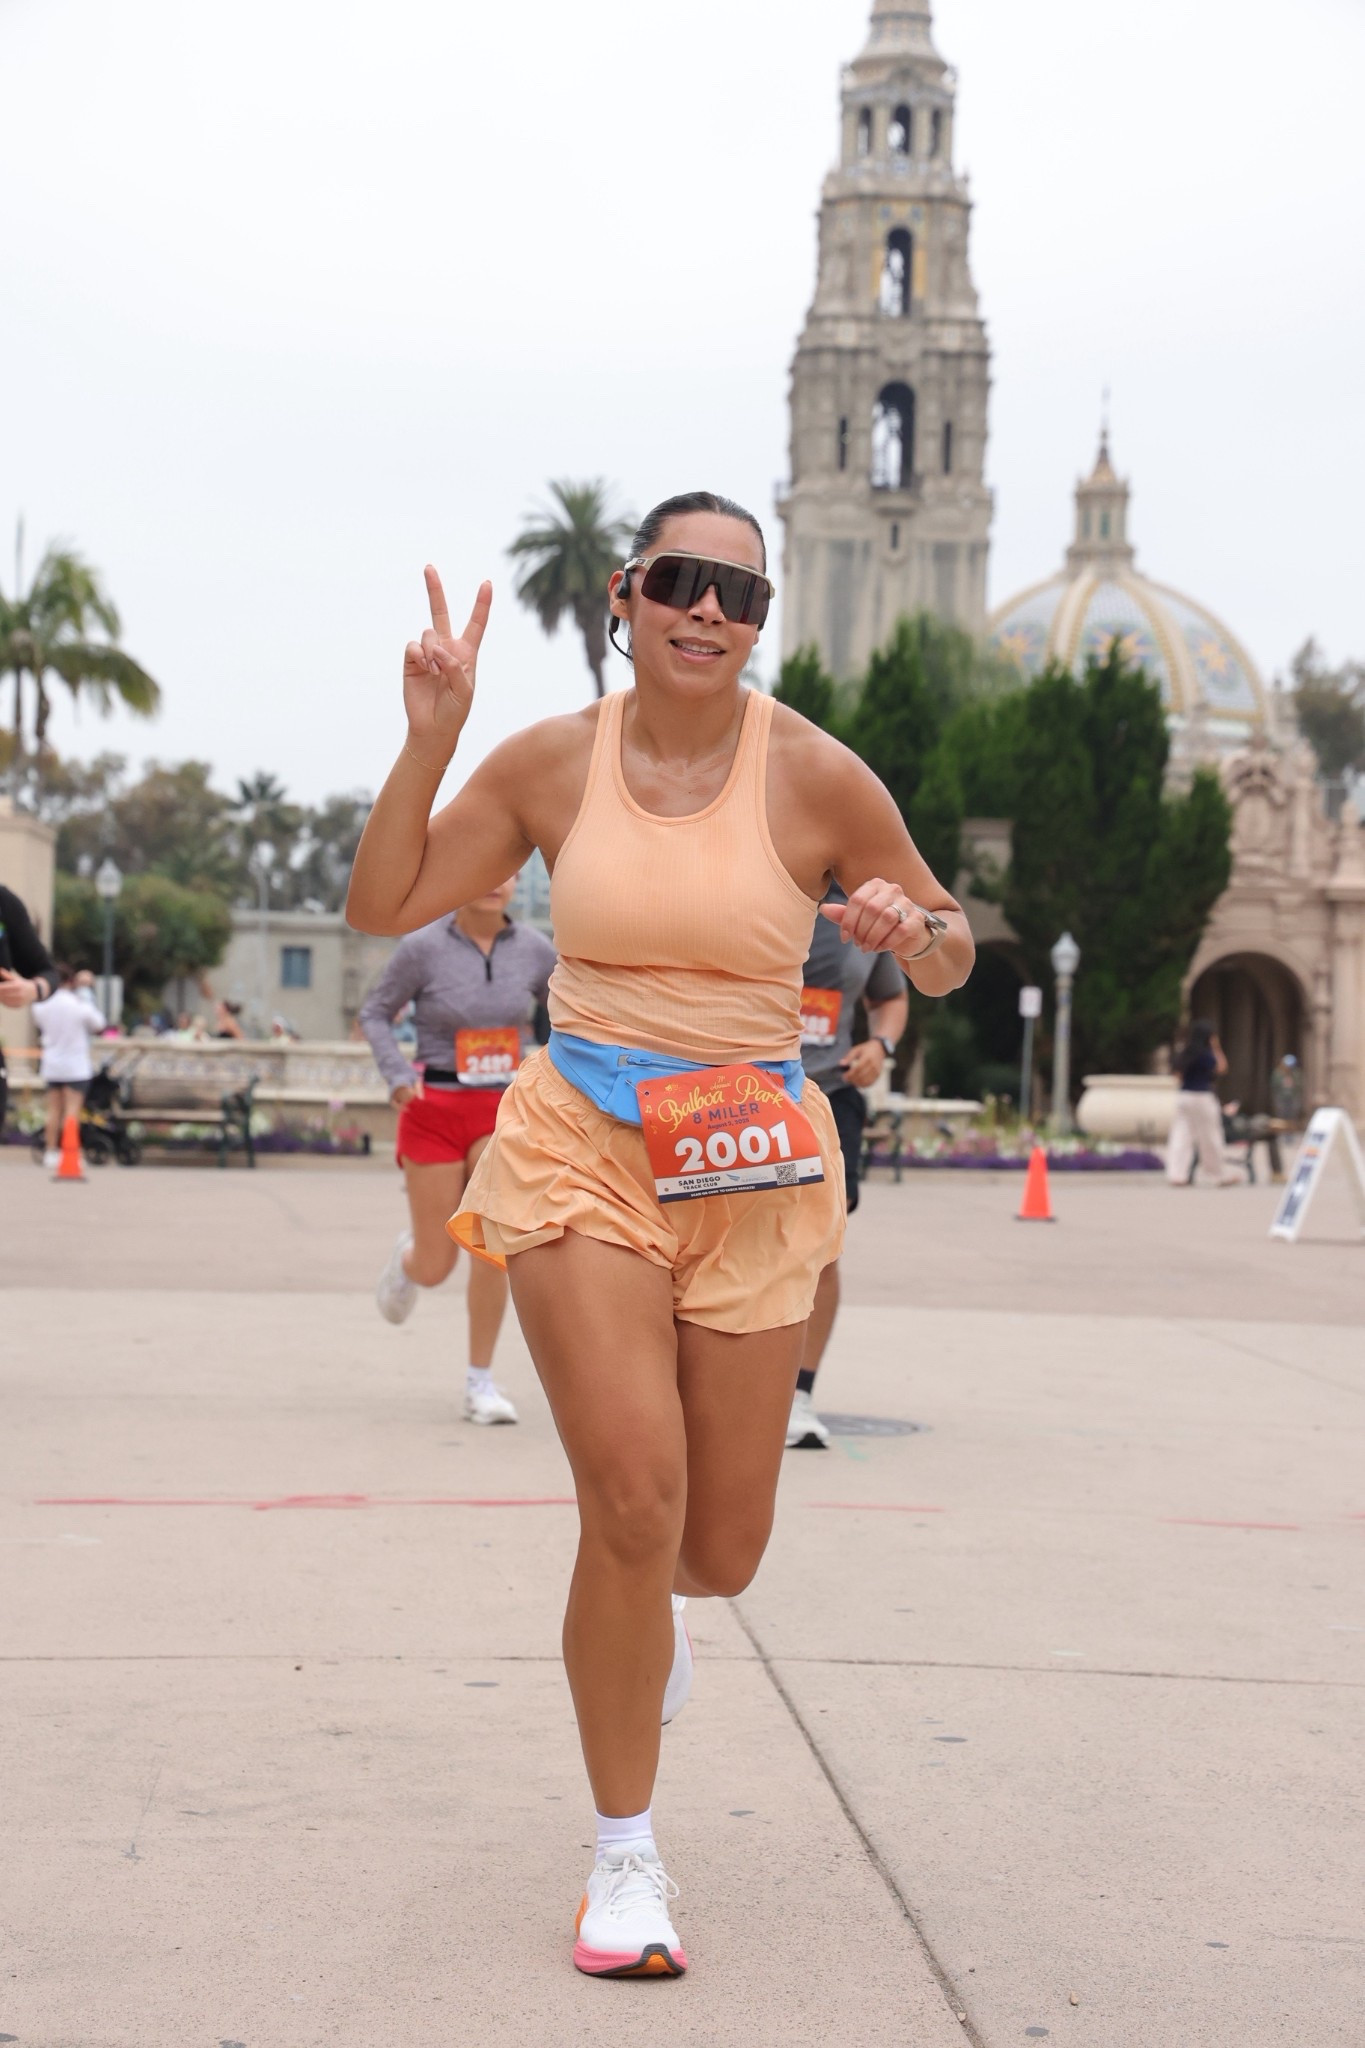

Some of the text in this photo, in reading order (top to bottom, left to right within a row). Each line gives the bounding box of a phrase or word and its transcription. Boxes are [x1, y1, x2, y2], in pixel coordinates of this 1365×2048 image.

[657, 1075, 784, 1133] Balboa Park
[693, 1102, 760, 1124] 8 MILER
[707, 1121, 728, 1130] August
[674, 1120, 792, 1173] 2001
[678, 1175, 721, 1187] SAN DIEGO
[682, 1183, 702, 1191] TRACK
